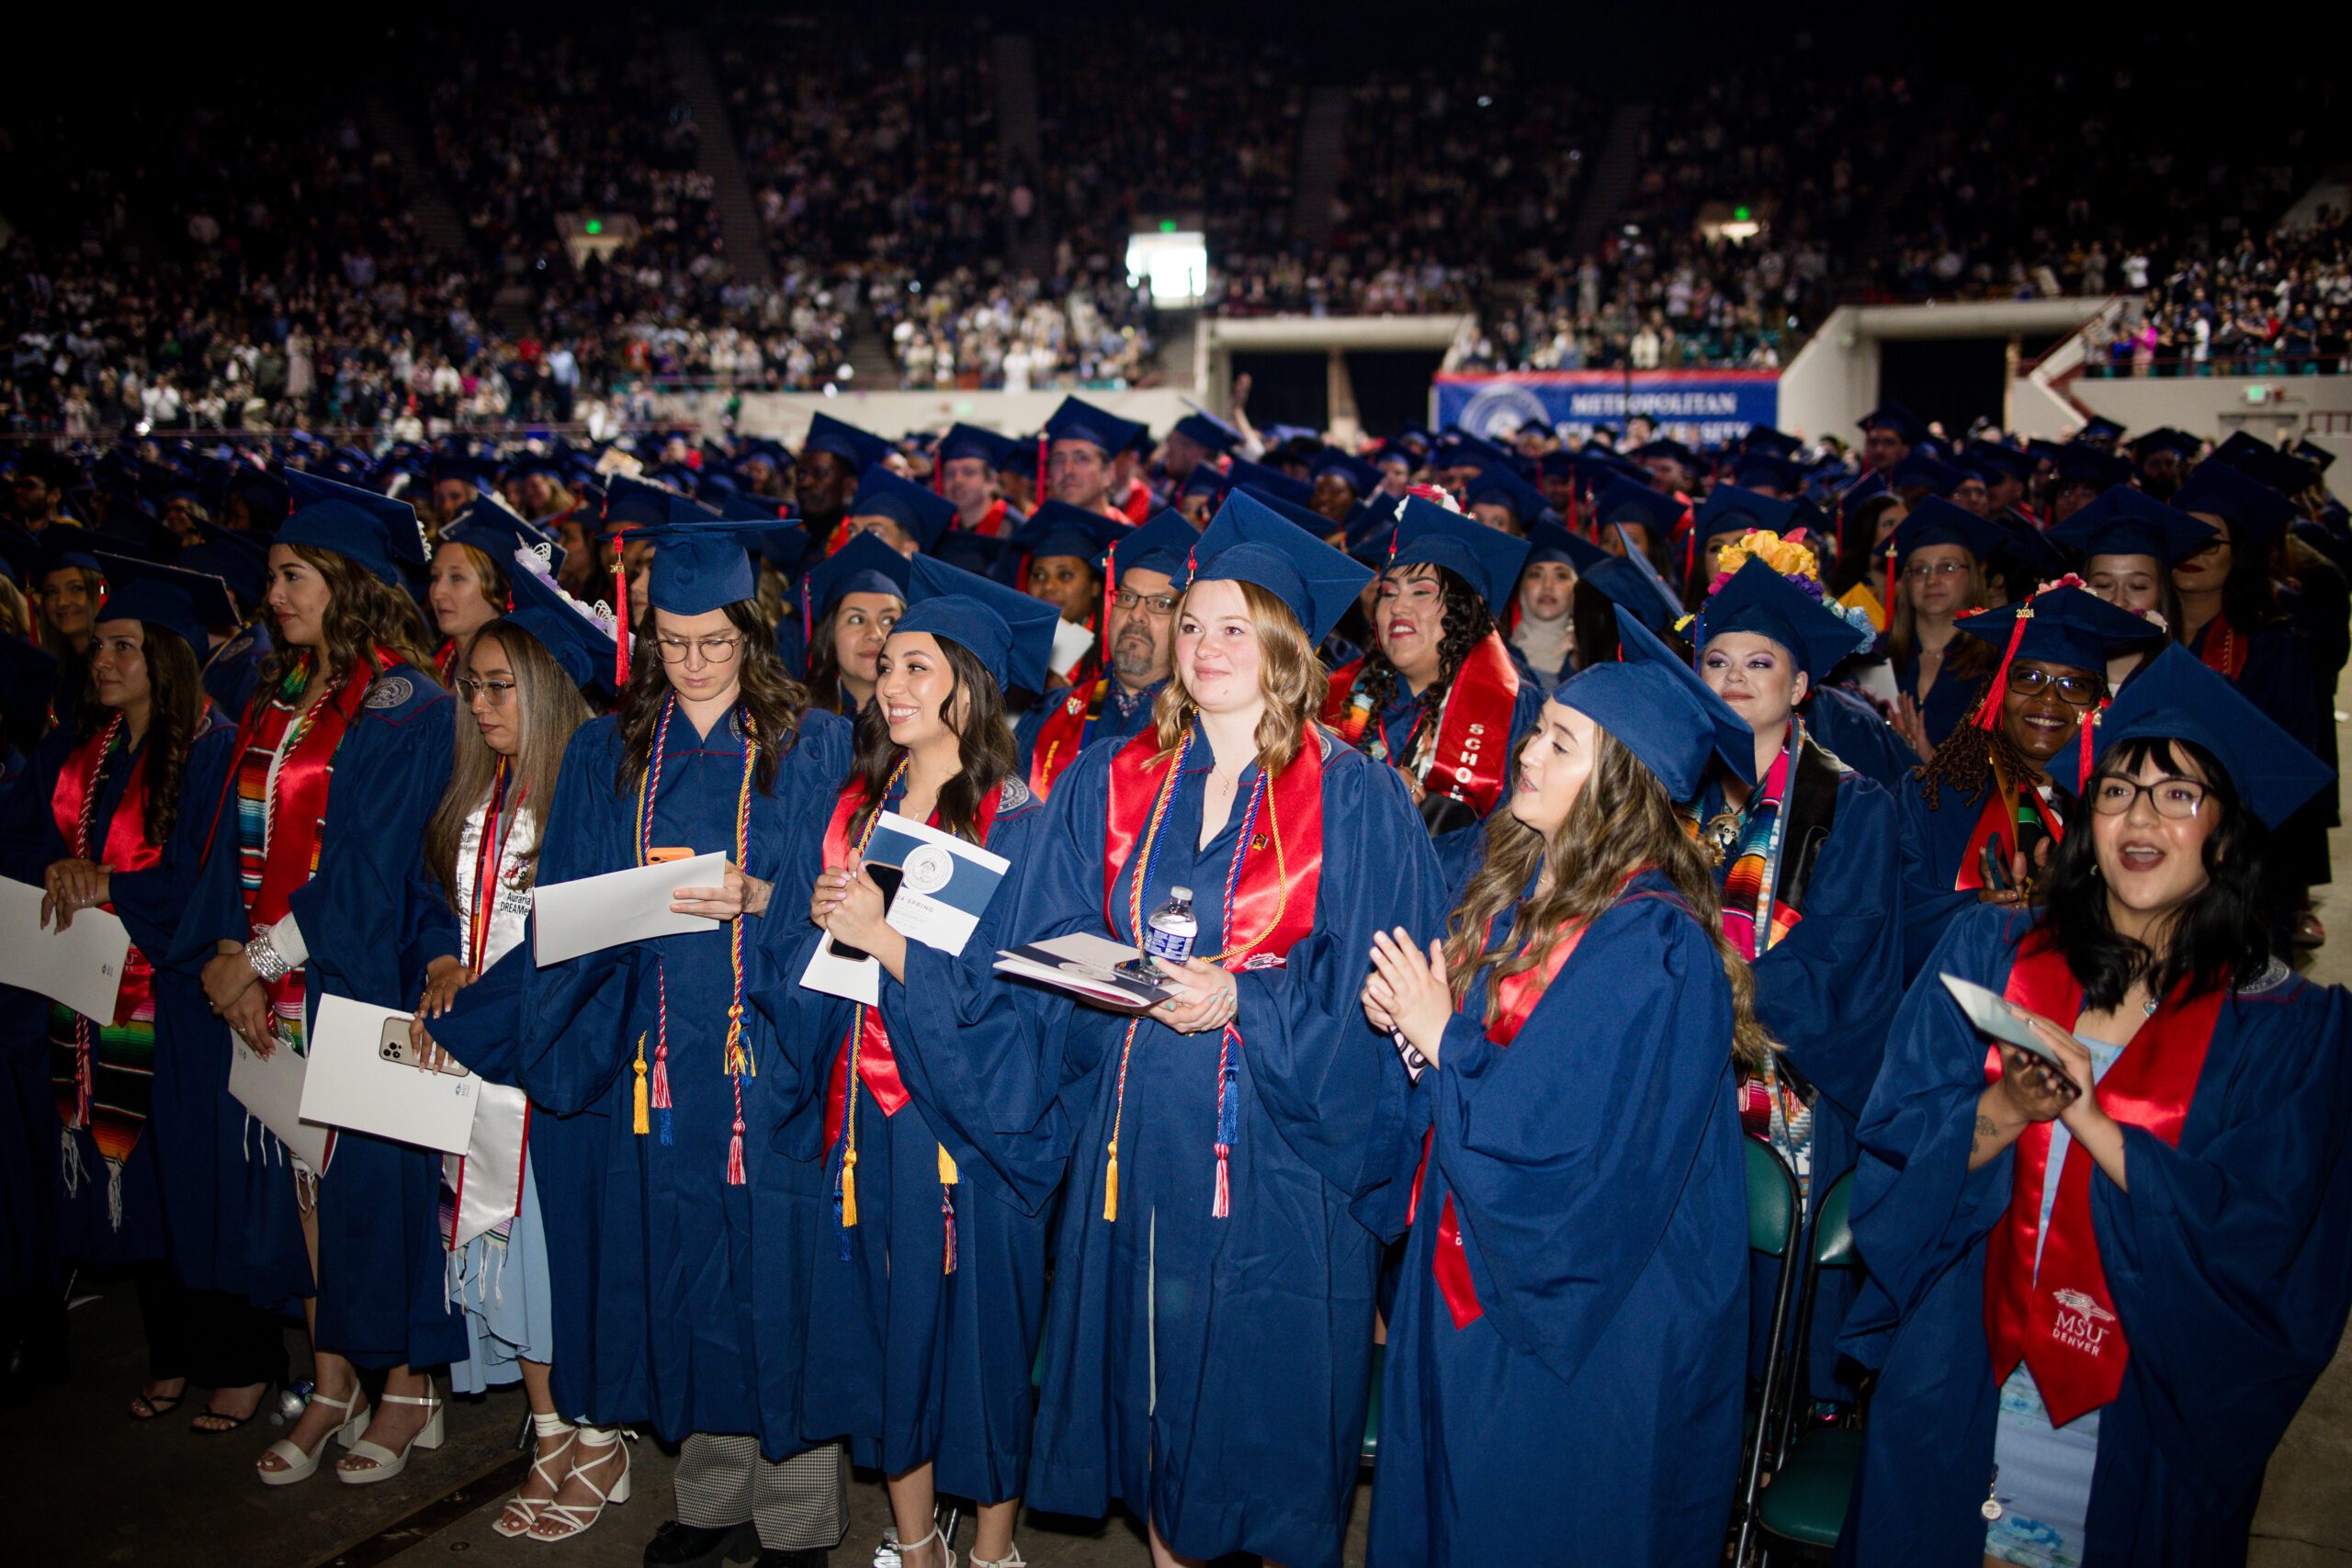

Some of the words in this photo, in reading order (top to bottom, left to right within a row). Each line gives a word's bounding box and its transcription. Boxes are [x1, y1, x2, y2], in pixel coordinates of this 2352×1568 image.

[1569, 392, 1738, 416] METROPOLITAN
[2016, 608, 2034, 618] 2024
[506, 891, 531, 906] Auraria
[908, 898, 933, 913] SPRING
[500, 901, 529, 916] DREAMe
[2054, 1309, 2103, 1344] MSU
[2052, 1328, 2100, 1357] DENVER
